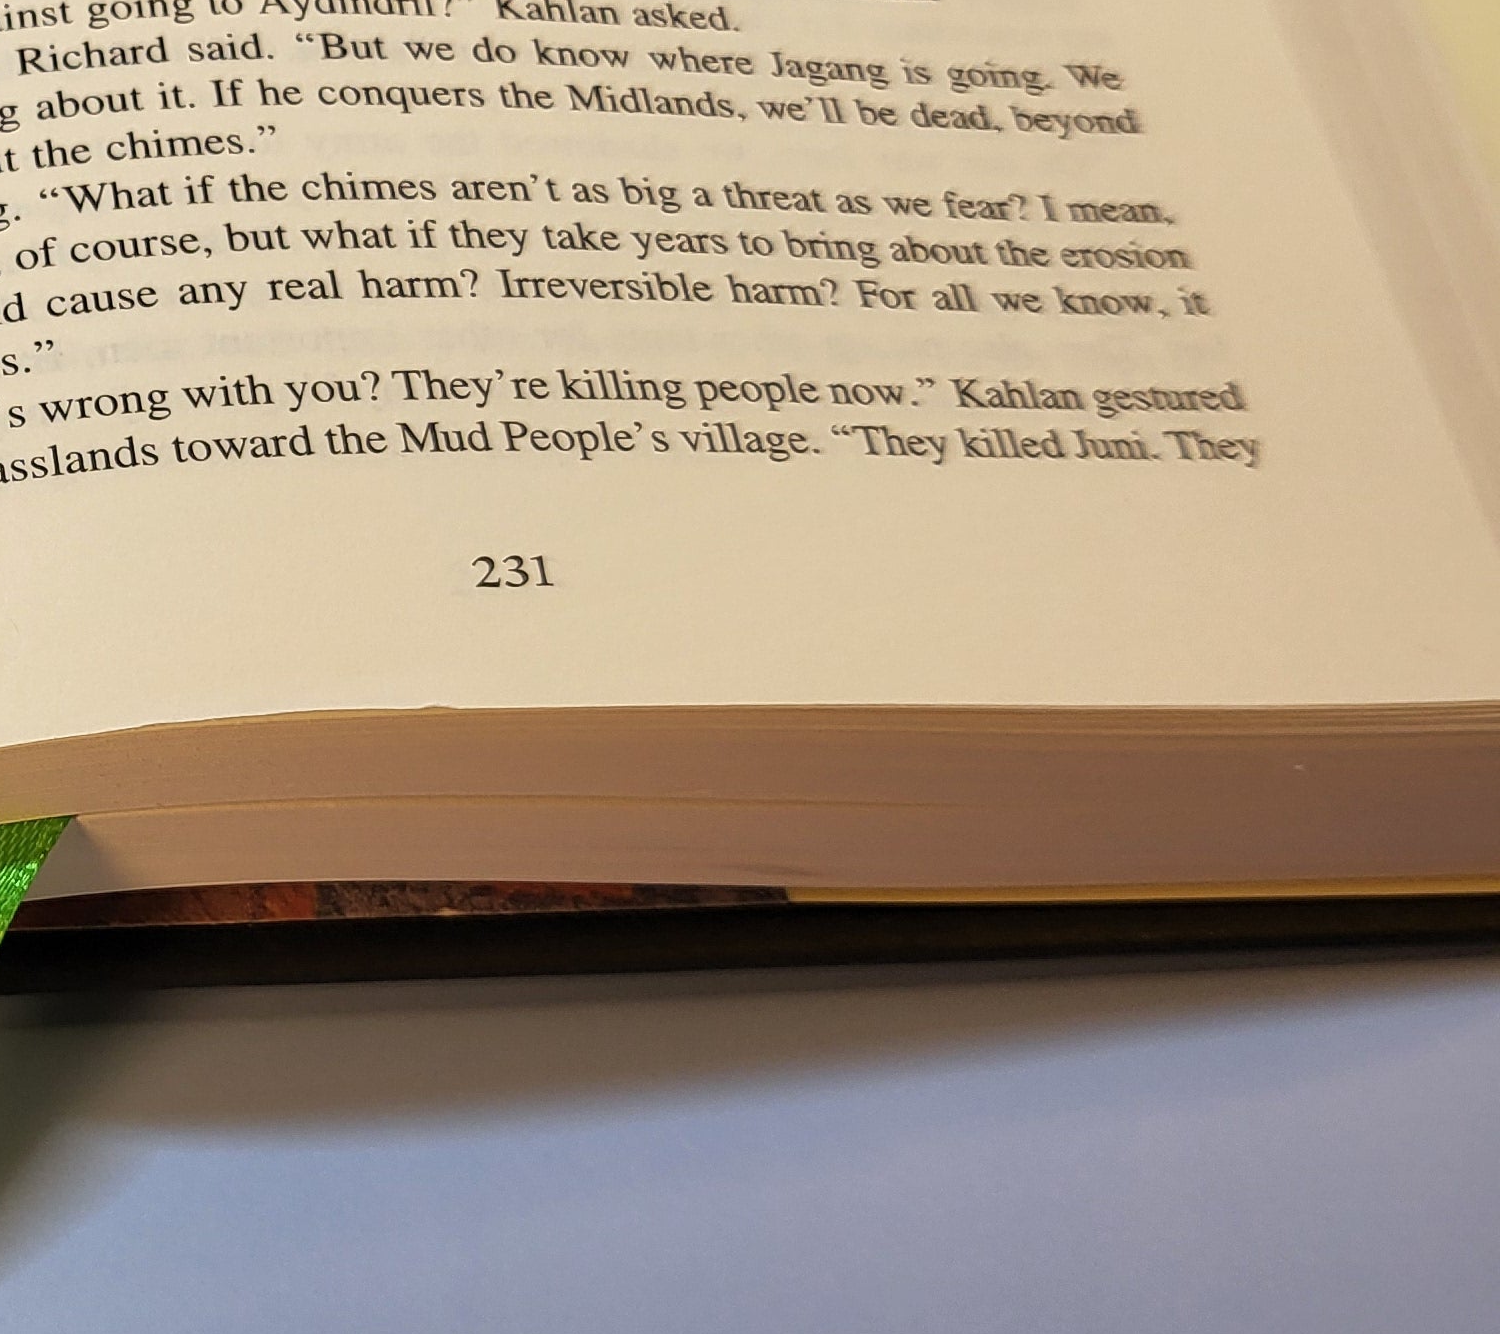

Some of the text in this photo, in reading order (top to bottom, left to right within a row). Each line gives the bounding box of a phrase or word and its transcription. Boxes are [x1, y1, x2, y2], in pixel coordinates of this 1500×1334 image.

[631, 2, 742, 34] asked.
[38, 180, 174, 215] “What
[184, 174, 216, 206] if
[227, 172, 290, 204] the
[300, 171, 439, 202] chimes
[450, 173, 563, 203] aren’t
[570, 182, 612, 205] as
[616, 176, 684, 215] big
[691, 186, 716, 209] a
[721, 180, 828, 214] threat
[834, 193, 875, 216] as
[880, 196, 935, 219] we
[941, 190, 1030, 222] fear?
[1036, 193, 1061, 224] I
[1064, 201, 1178, 227] mean,
[170, 424, 317, 465] toward
[323, 422, 389, 457] the
[395, 420, 495, 455] Mud
[499, 420, 672, 463] People’s
[677, 421, 823, 464] village.
[829, 424, 949, 467] “They
[954, 427, 1069, 461] killed
[1071, 429, 1164, 462] Juni.
[1172, 430, 1263, 471] They
[470, 554, 556, 590] 231
